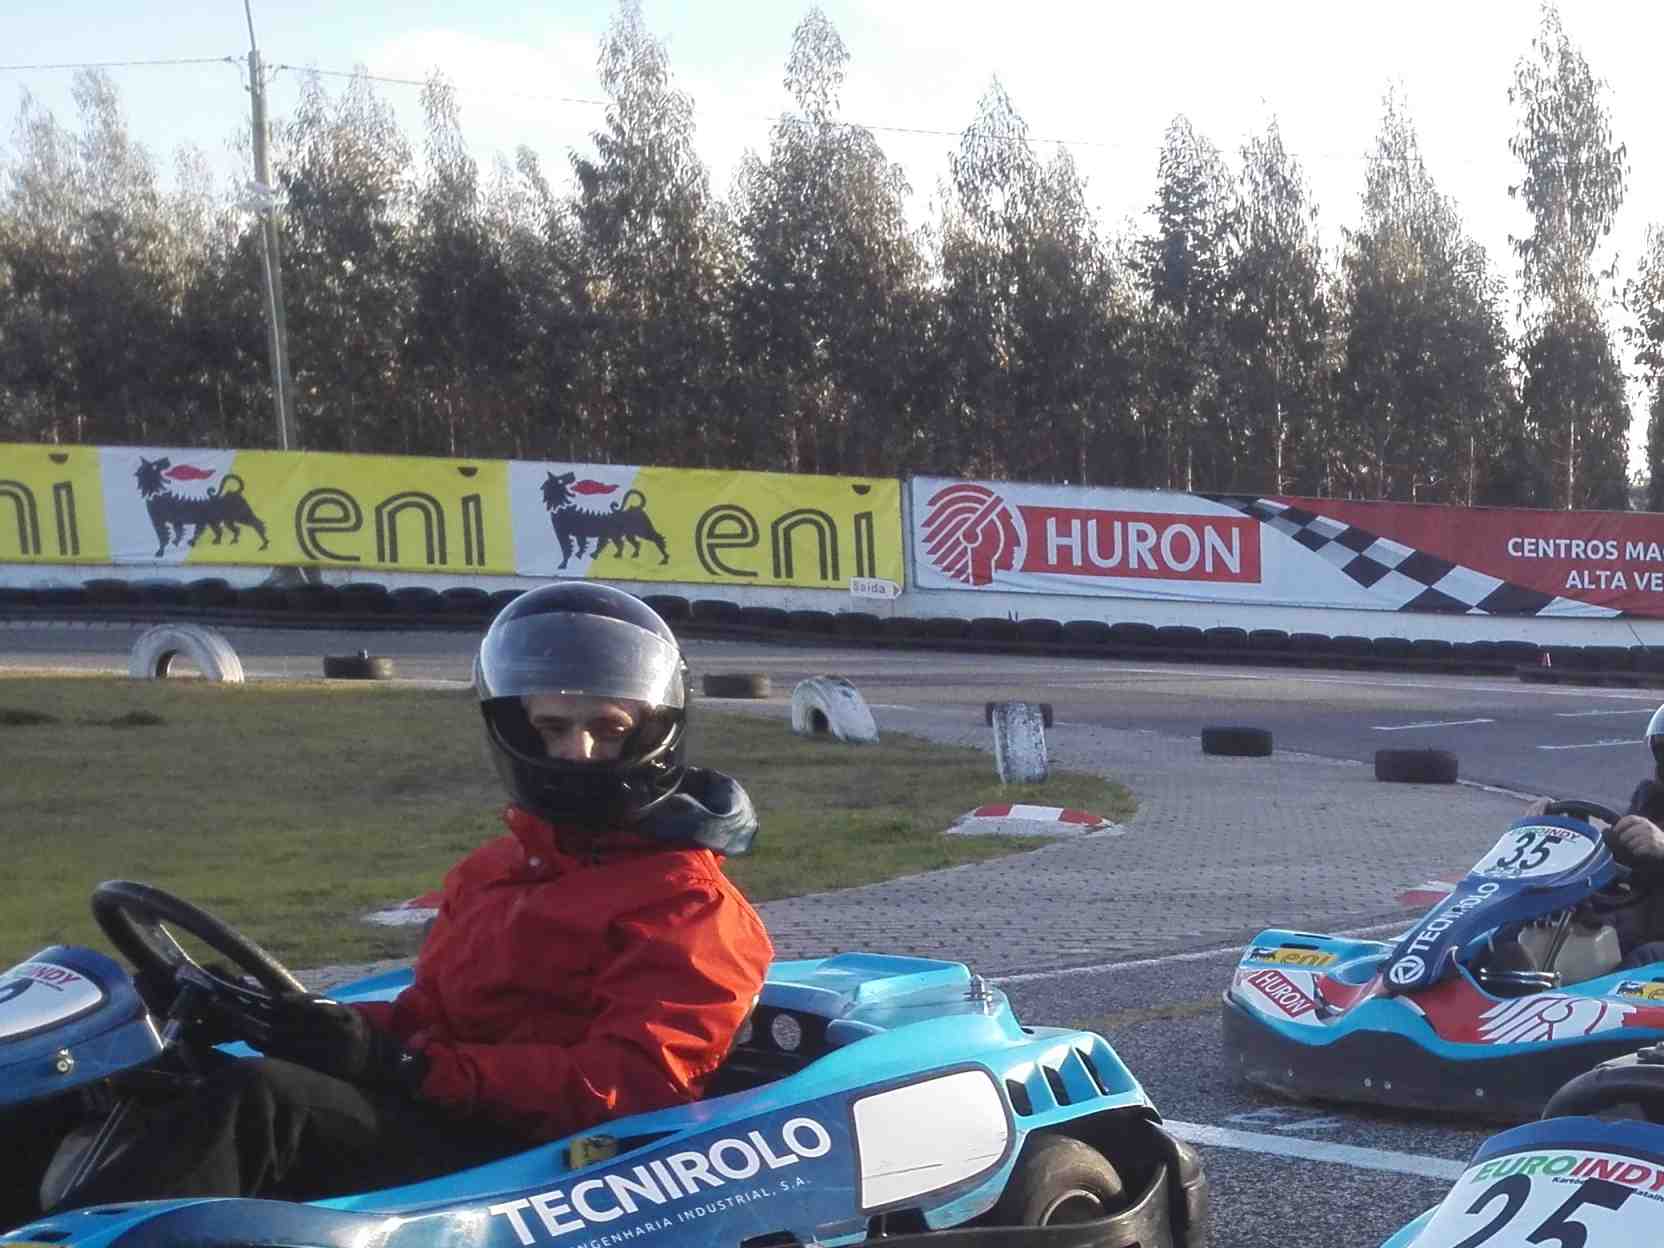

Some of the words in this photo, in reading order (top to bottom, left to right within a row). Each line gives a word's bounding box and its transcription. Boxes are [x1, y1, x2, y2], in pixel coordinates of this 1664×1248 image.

[295, 466, 486, 567] eni
[696, 483, 876, 581] eni
[1046, 517, 1242, 575] HURON
[1507, 536, 1618, 561] CENTROS
[1565, 569, 1627, 591] ALTA
[1496, 832, 1563, 869] 35
[1255, 971, 1312, 1013] HURON
[488, 1117, 832, 1247] TECNIROLO
[677, 1186, 777, 1223] INDUSTRIAL,
[779, 1175, 812, 1193] S.A.
